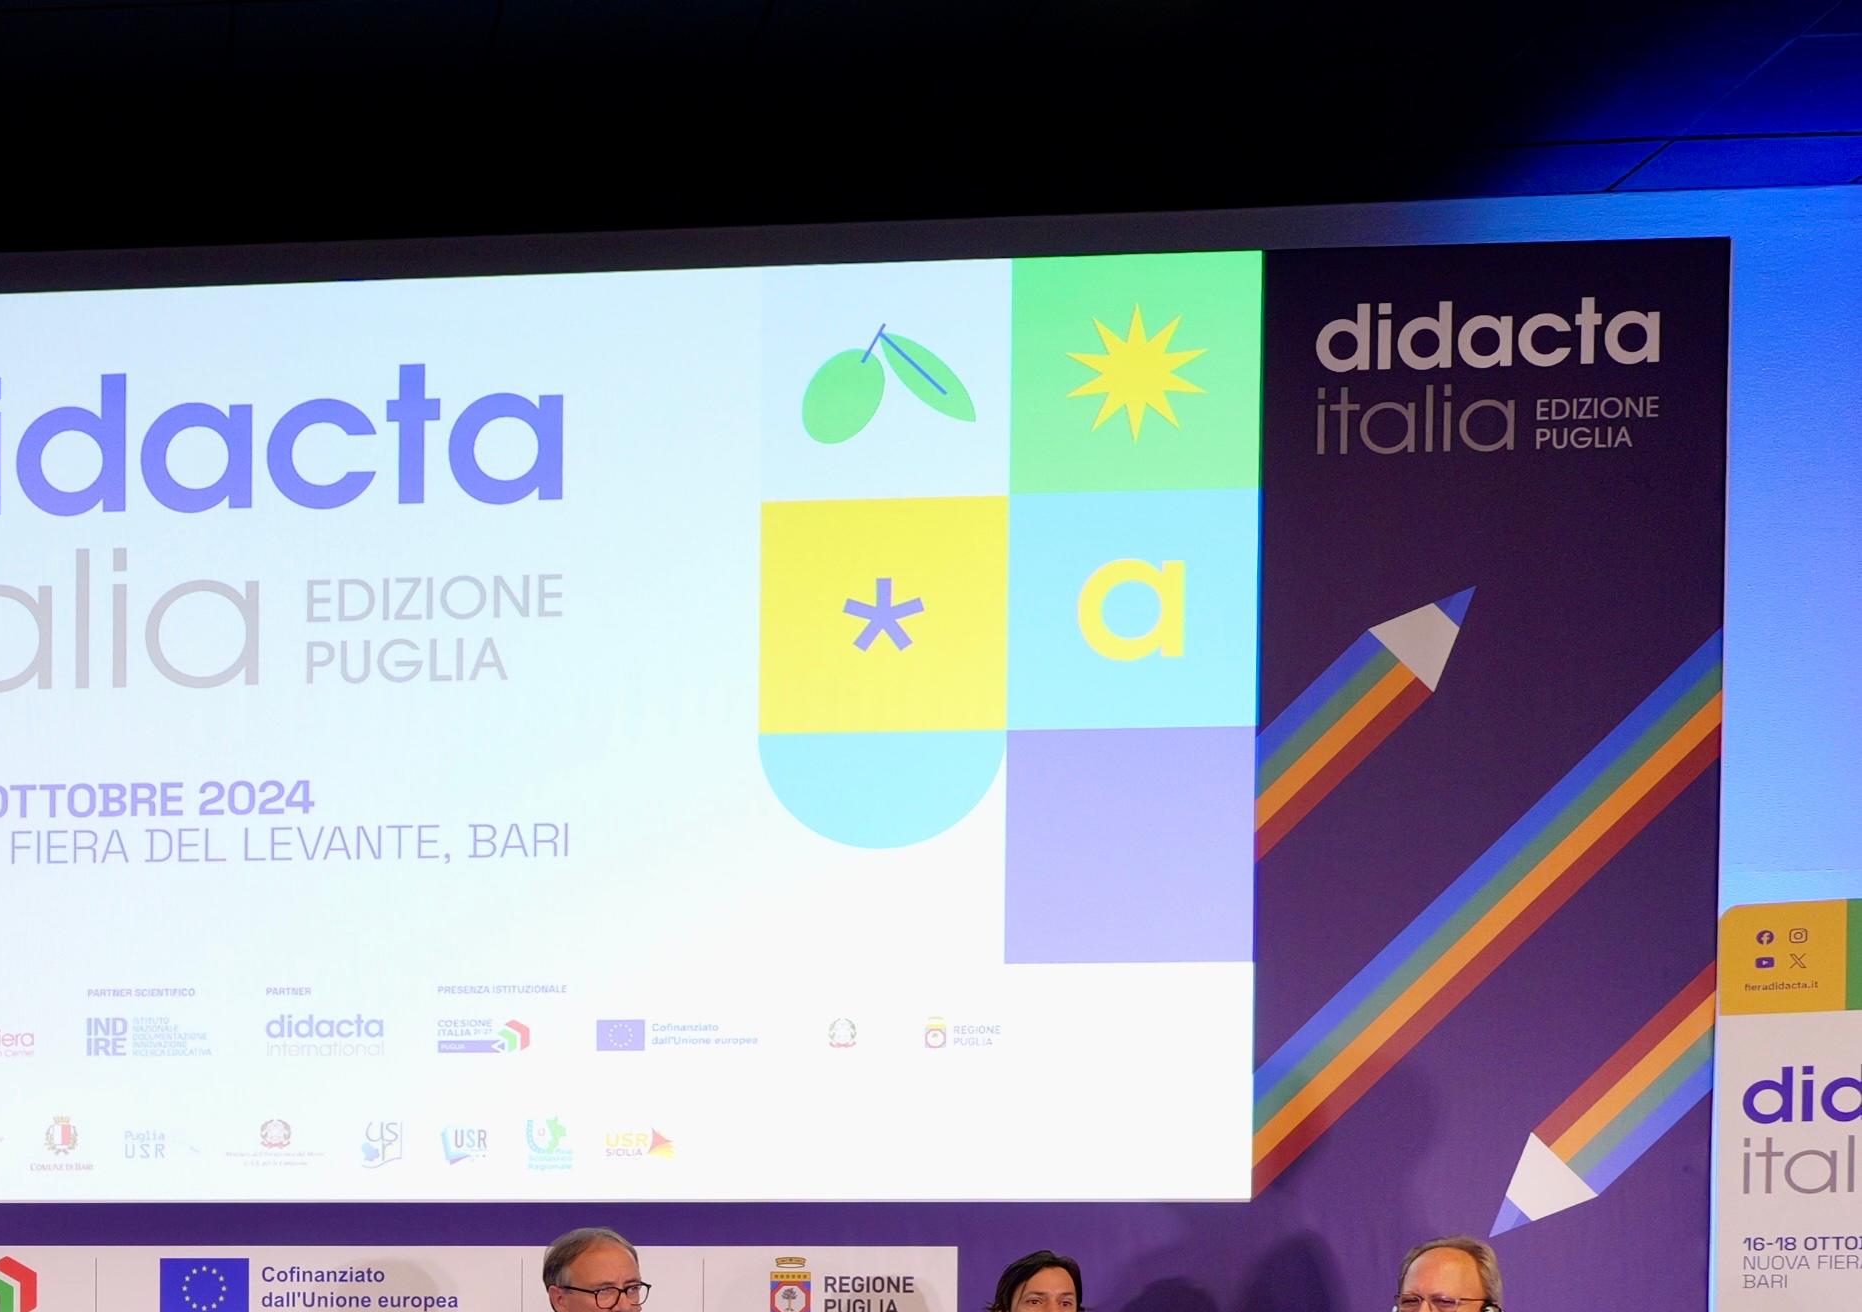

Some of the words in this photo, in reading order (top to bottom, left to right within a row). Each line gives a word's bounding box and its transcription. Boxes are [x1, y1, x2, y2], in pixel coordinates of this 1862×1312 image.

[1316, 296, 1661, 373] didacta
[1536, 396, 1660, 421] EDIZIONE
[1316, 384, 1516, 455] italia
[1536, 426, 1634, 450] PUGLIA
[305, 574, 564, 623] EDIZIONE
[1077, 558, 1185, 662] a
[305, 637, 508, 684] PUGLIA
[198, 779, 316, 816] 2024
[10, 828, 130, 864] FIERA
[144, 827, 227, 863] DEL
[244, 824, 452, 865] LEVANTE,
[468, 822, 570, 859] BARI
[87, 988, 132, 998] PARTNER
[266, 986, 312, 996] PARTNER
[437, 985, 490, 995] PRESENZA
[1744, 980, 1819, 991] fieradidacta.it
[266, 1013, 385, 1039] didacta
[437, 1019, 493, 1028] COESIONE
[651, 1022, 719, 1033] Cofinanziato
[953, 1025, 1002, 1034] REGIONE
[437, 1028, 472, 1037] ITALIA
[266, 1040, 386, 1057] international
[953, 1037, 993, 1046] PUGLIA
[453, 1129, 487, 1149] USR
[1743, 1236, 1797, 1251] 16-18
[1743, 1255, 1810, 1270] NUOVA
[1817, 1254, 1862, 1270] FIER
[261, 1266, 385, 1283] Cofinanziato
[1742, 1274, 1788, 1289] BARI
[824, 1276, 915, 1293] REGIONE
[261, 1291, 371, 1308] dall'Unione
[378, 1294, 459, 1312] europea
